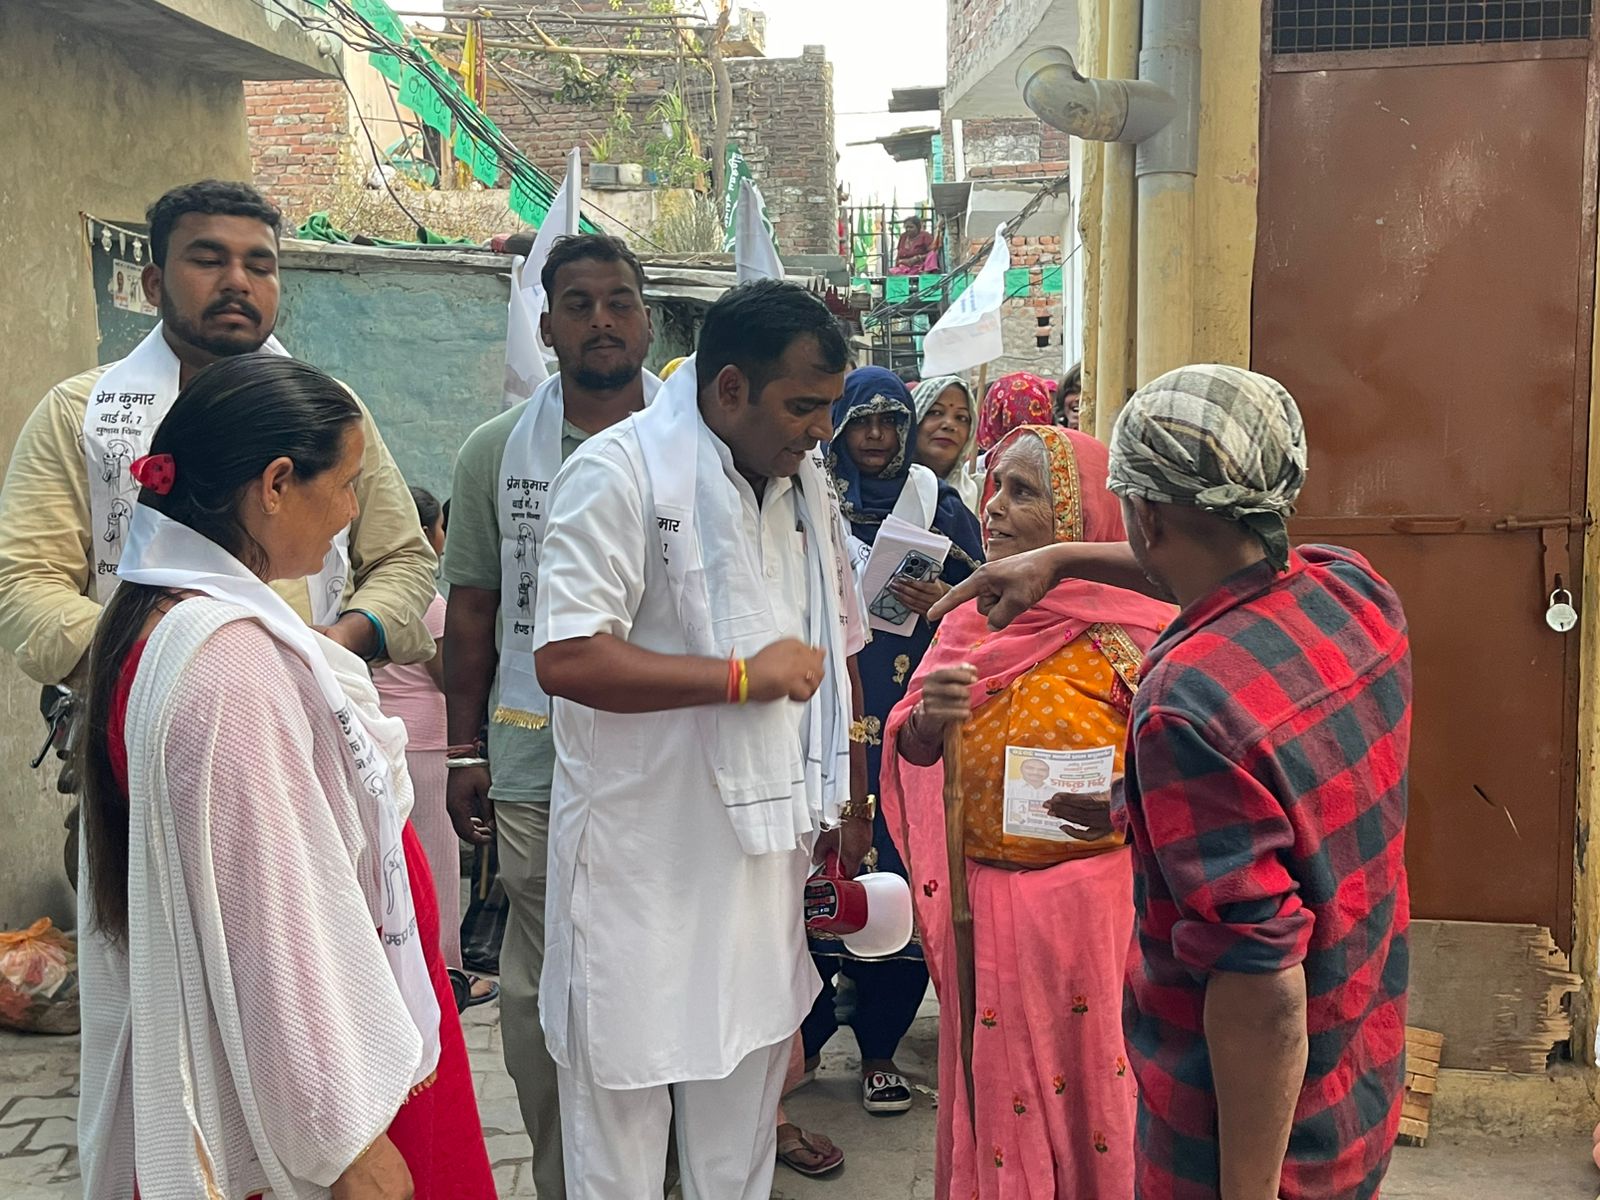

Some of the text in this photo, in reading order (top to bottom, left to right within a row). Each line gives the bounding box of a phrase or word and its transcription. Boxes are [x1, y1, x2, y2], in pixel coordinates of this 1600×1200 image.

[95, 391, 156, 409] प्रेम कुमार
[101, 410, 120, 423] वार्ड
[136, 415, 142, 425] 7
[506, 475, 549, 496] प्रेम कुमार
[535, 501, 539, 510] 7
[656, 516, 681, 532] मार
